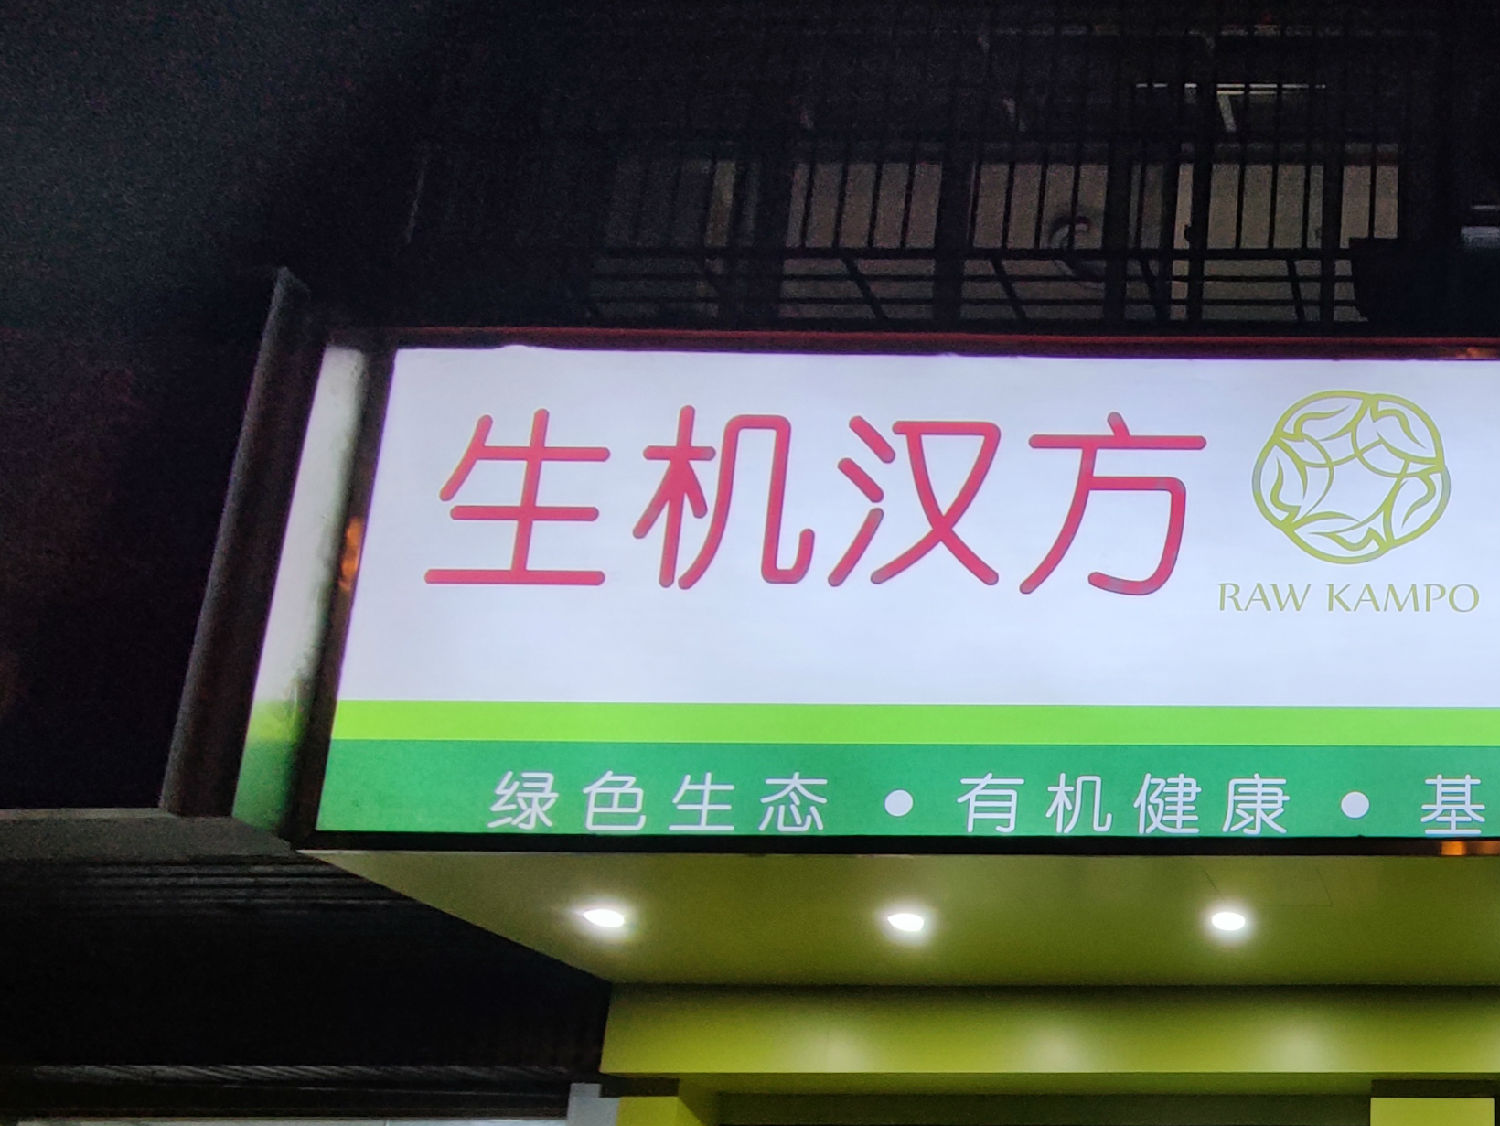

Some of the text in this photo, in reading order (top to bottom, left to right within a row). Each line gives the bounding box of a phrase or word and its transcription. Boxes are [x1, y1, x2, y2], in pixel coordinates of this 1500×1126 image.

[425, 405, 1206, 595] 生机汉方
[1218, 583, 1480, 612] RAW KAMPO
[487, 771, 829, 834] 绿色生态
[957, 773, 1290, 836] 有机健康
